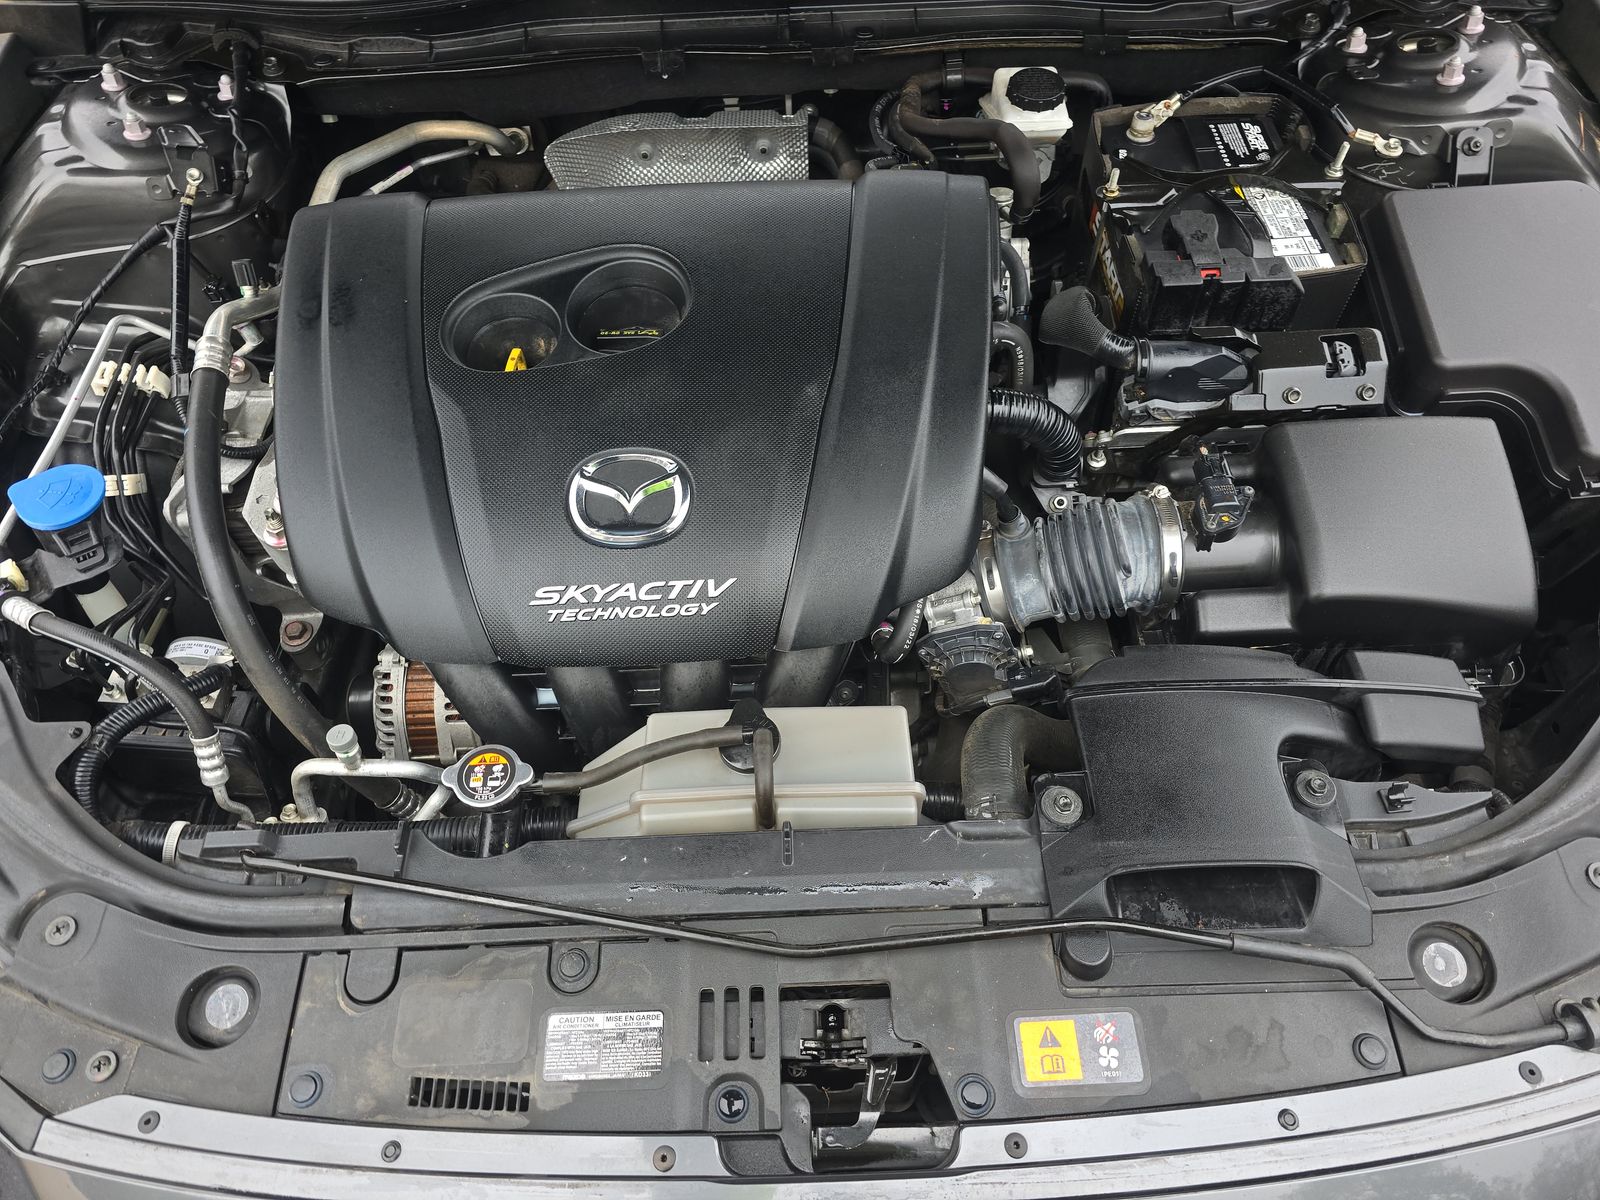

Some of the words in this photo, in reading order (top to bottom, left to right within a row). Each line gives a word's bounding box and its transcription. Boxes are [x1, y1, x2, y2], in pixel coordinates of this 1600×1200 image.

[529, 577, 738, 606] SKYACTIV
[548, 602, 719, 623] TECHNOLOGY
[559, 1016, 595, 1024] CAUTION
